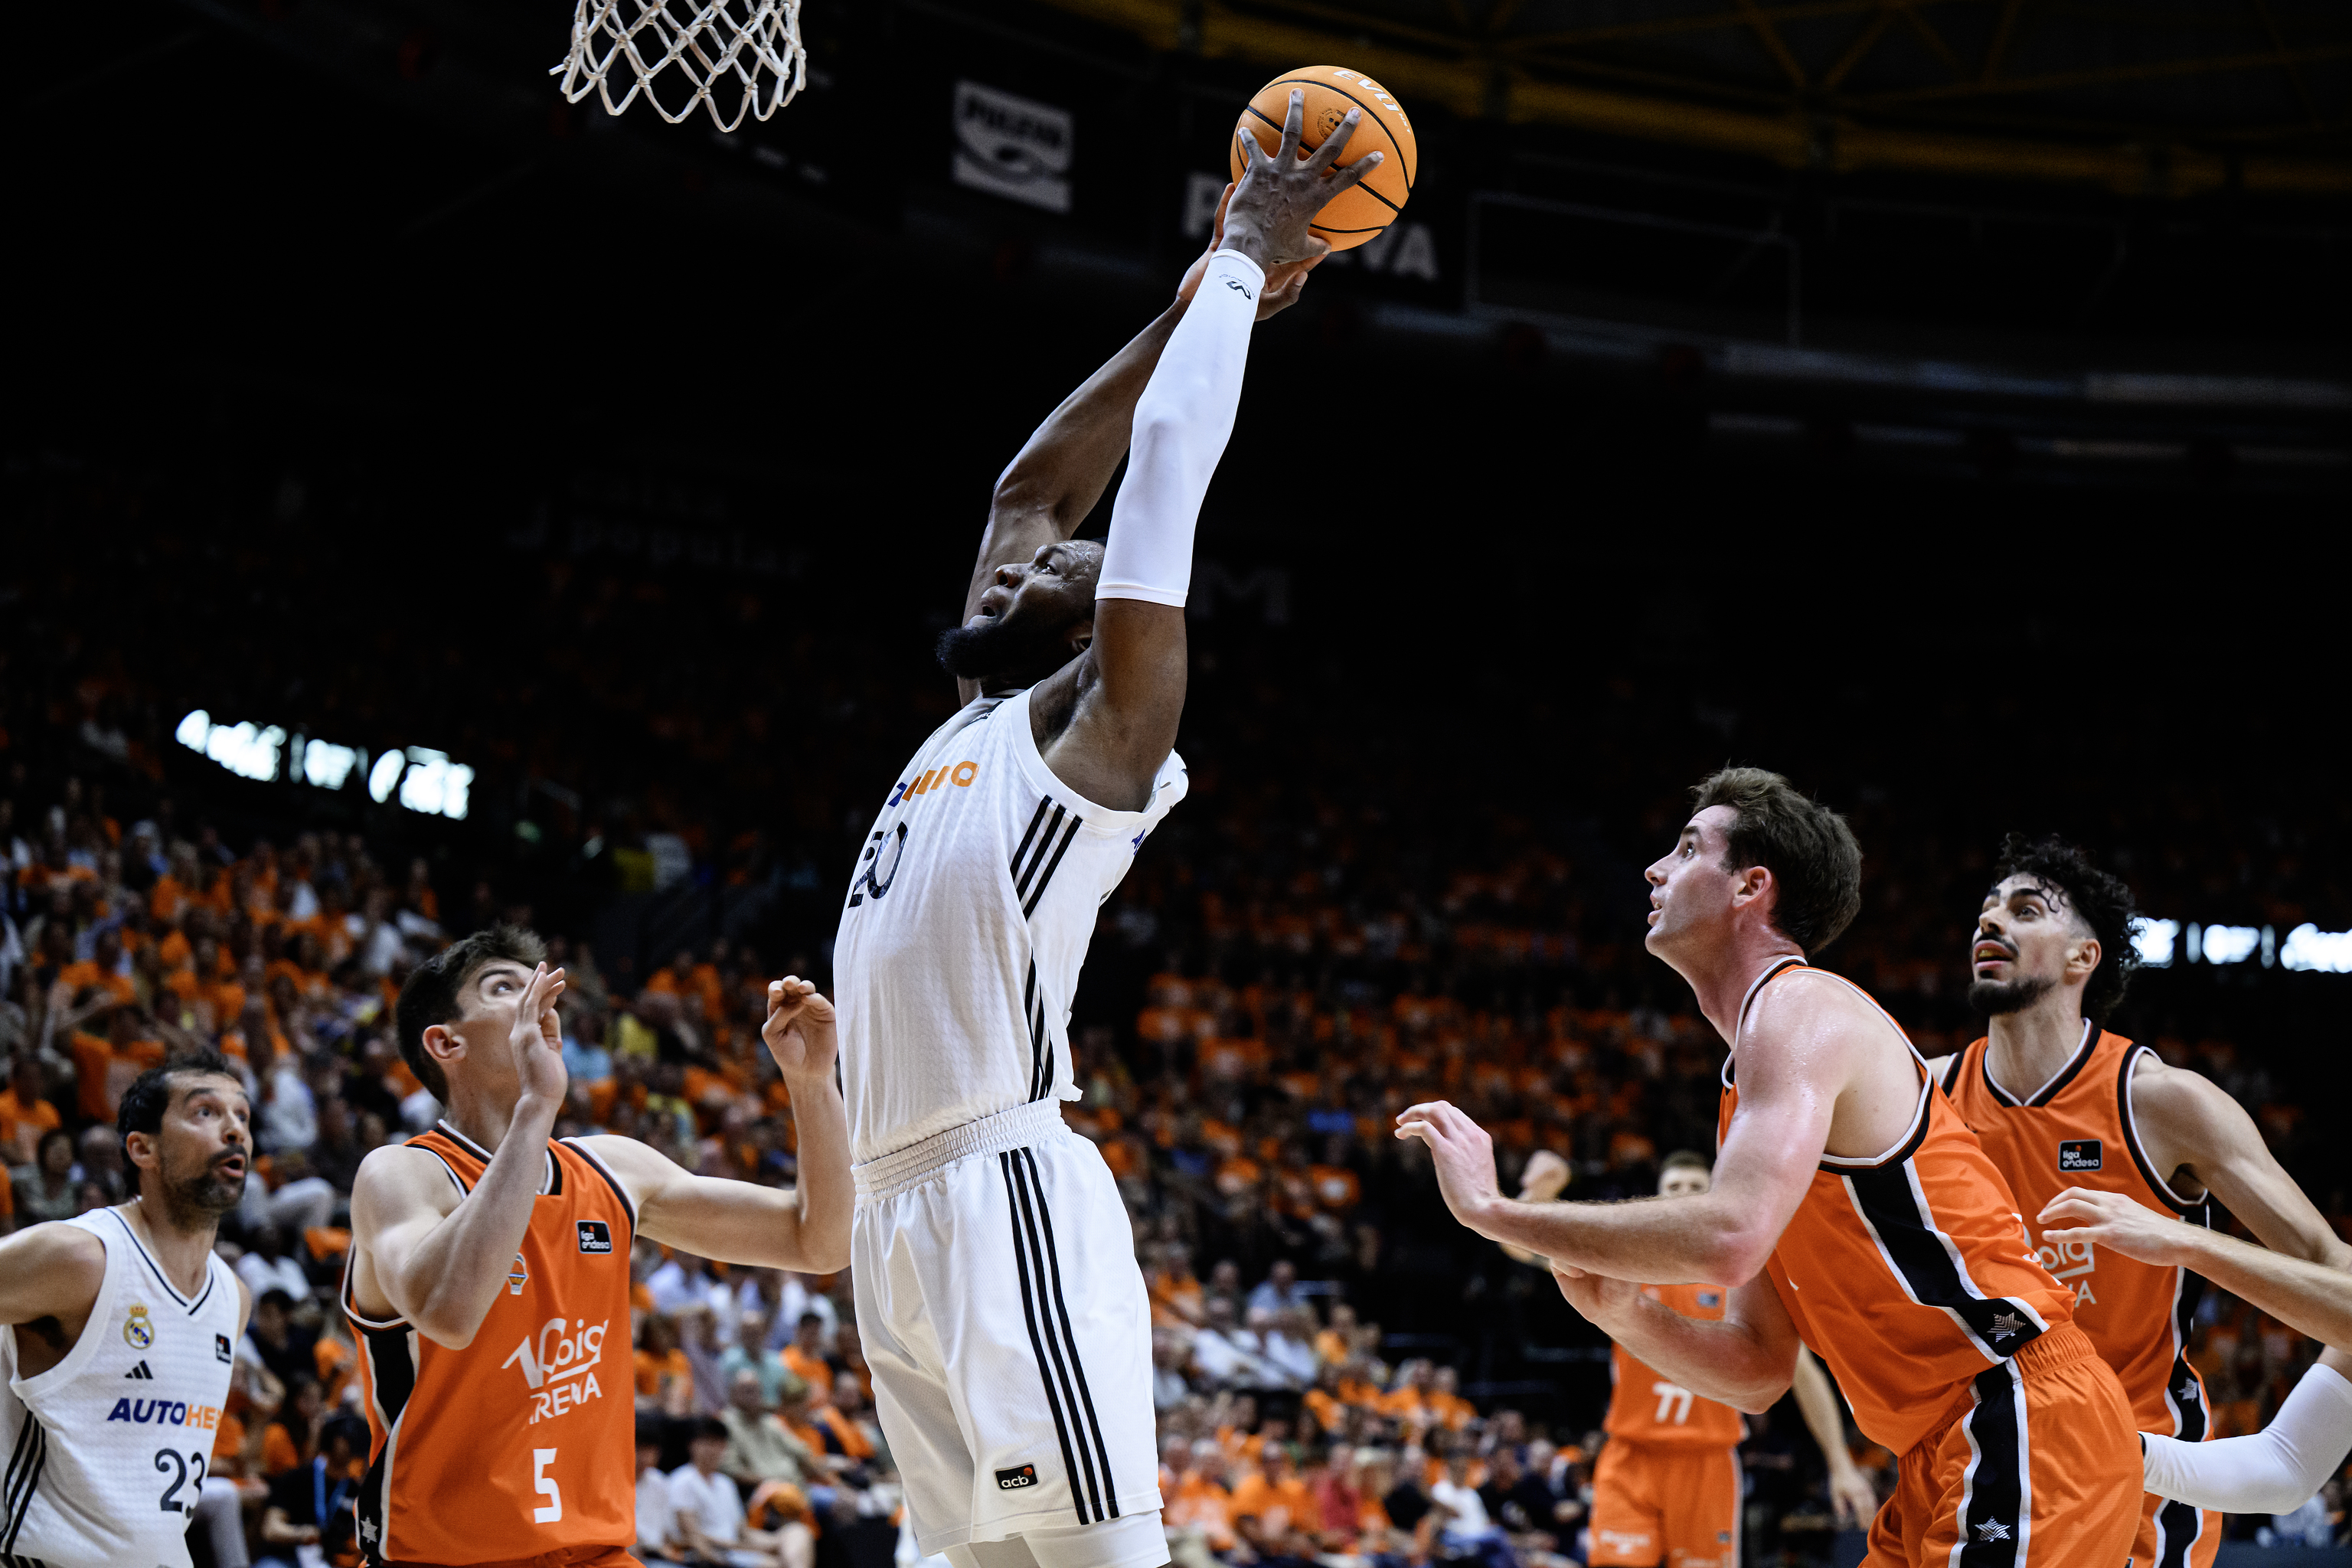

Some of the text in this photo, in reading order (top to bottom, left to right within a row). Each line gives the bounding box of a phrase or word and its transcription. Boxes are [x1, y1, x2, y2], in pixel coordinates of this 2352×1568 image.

[1333, 70, 1400, 112] EVO
[2063, 1149, 2080, 1161] liga
[2063, 1158, 2099, 1168] endesa
[155, 1448, 205, 1519] 23
[534, 1448, 563, 1523] 5
[1001, 1475, 1029, 1488] acb
